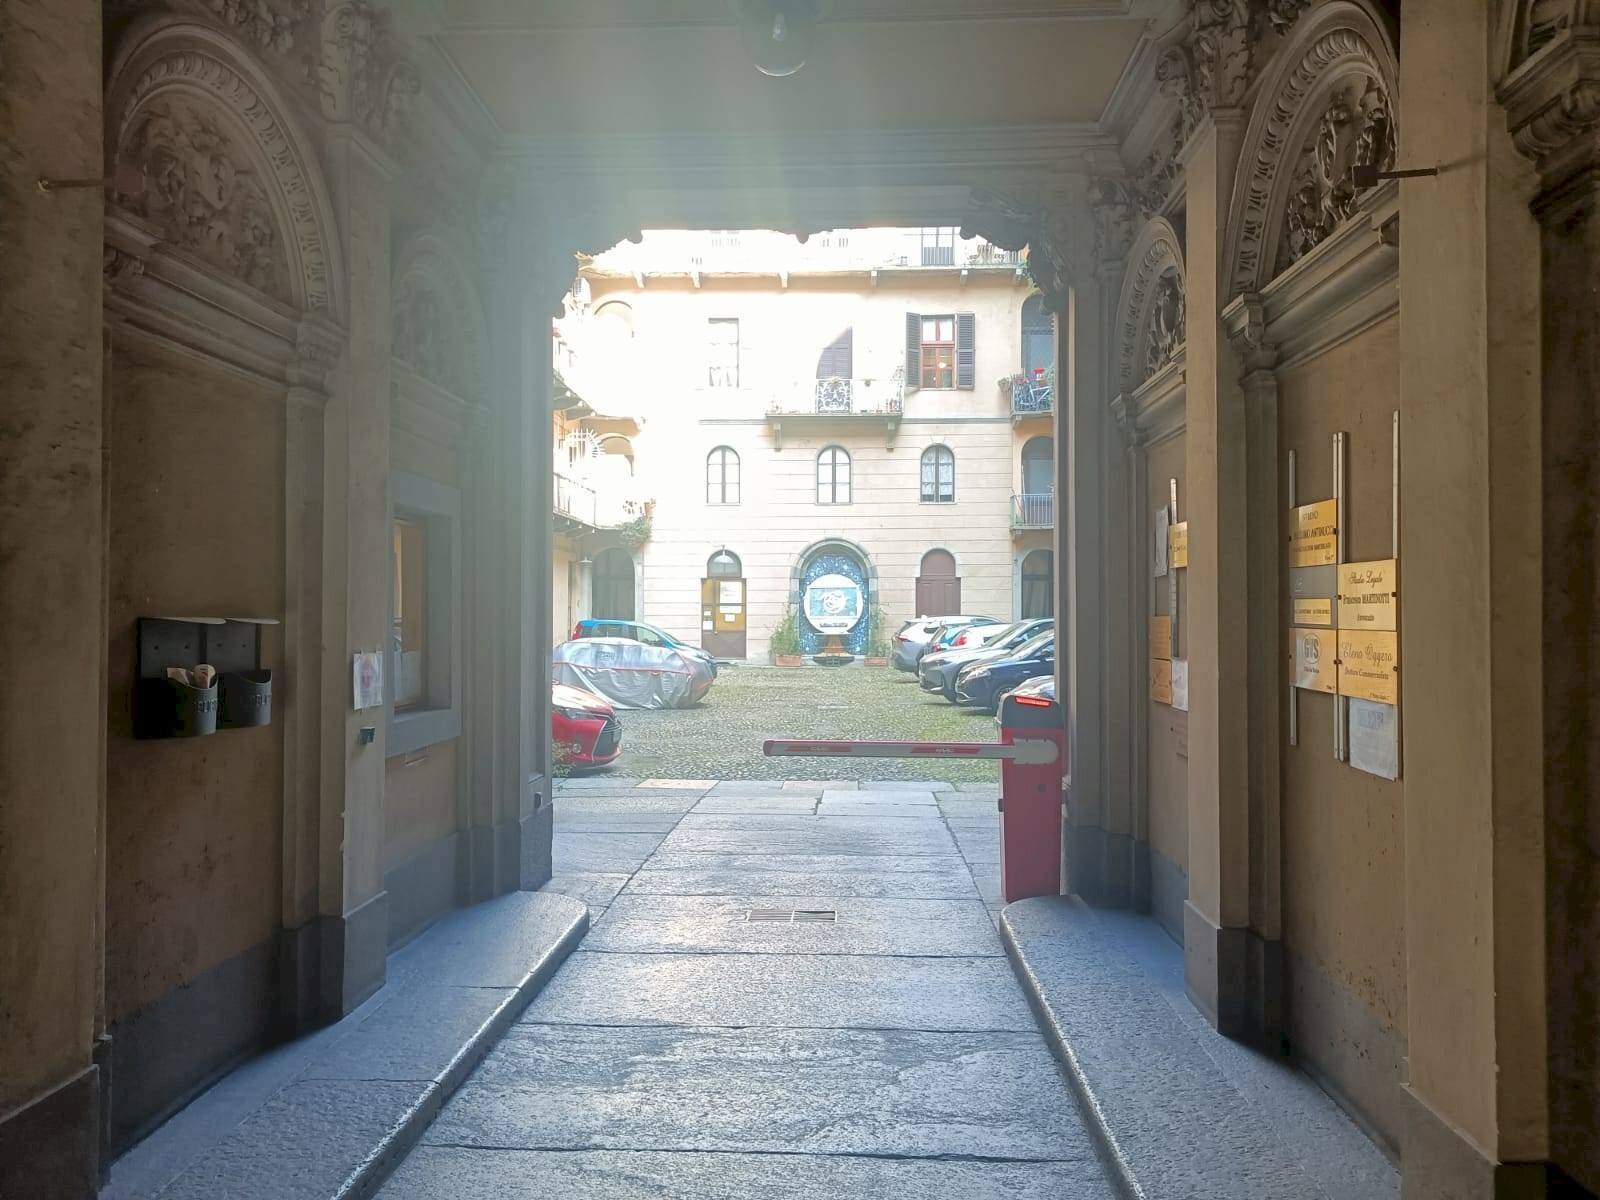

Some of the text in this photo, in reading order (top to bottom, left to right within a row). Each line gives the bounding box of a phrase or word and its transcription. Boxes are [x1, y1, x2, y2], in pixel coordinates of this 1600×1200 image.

[1302, 510, 1318, 521] STUDIO
[1349, 570, 1383, 588] Studio Legale
